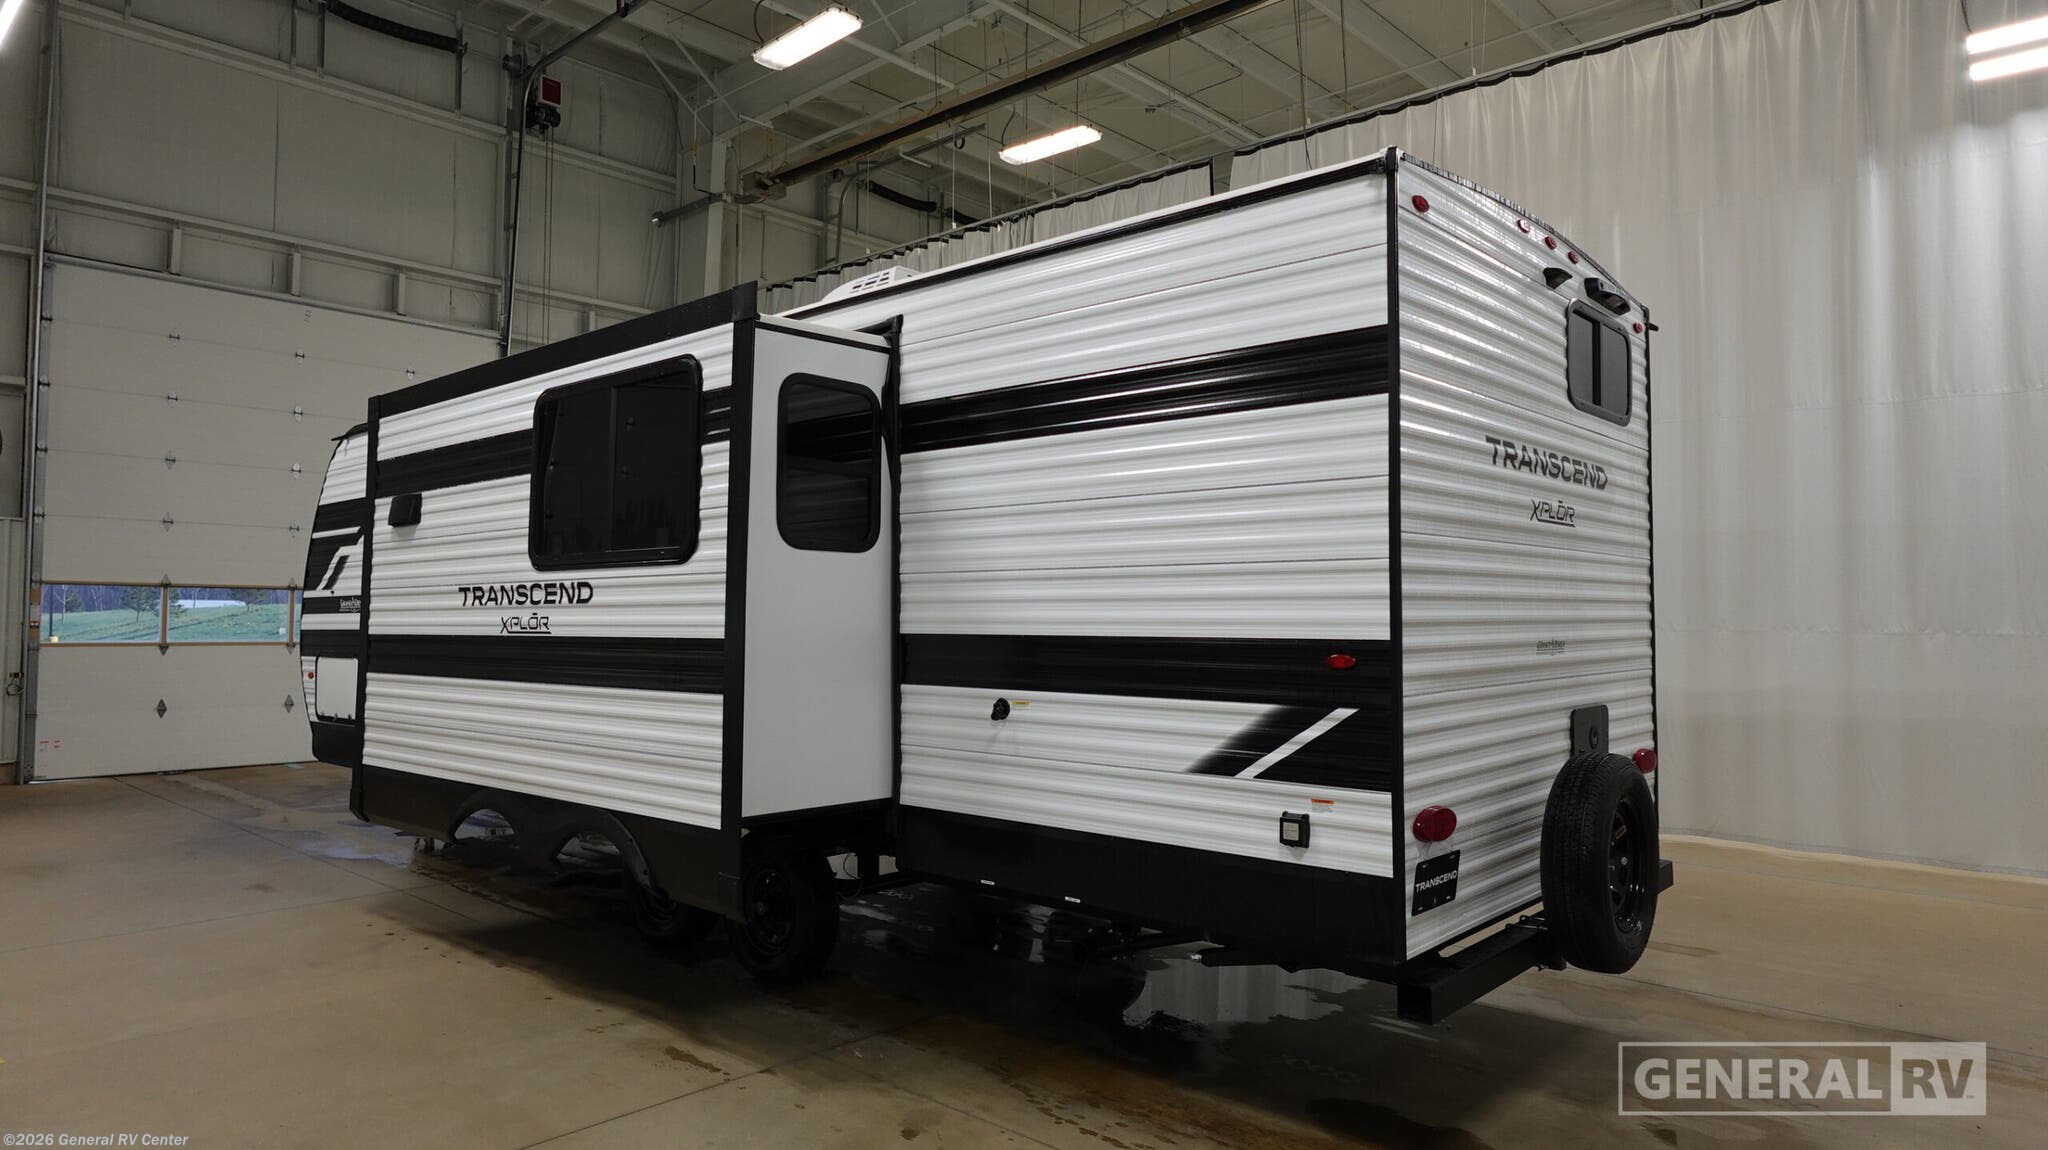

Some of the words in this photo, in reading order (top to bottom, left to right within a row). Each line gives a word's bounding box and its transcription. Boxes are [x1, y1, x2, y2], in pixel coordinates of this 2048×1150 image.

[1485, 435, 1608, 489] TRANSCEND
[458, 581, 594, 607] TRANSCEND
[1415, 870, 1458, 893] TRANSCEND
